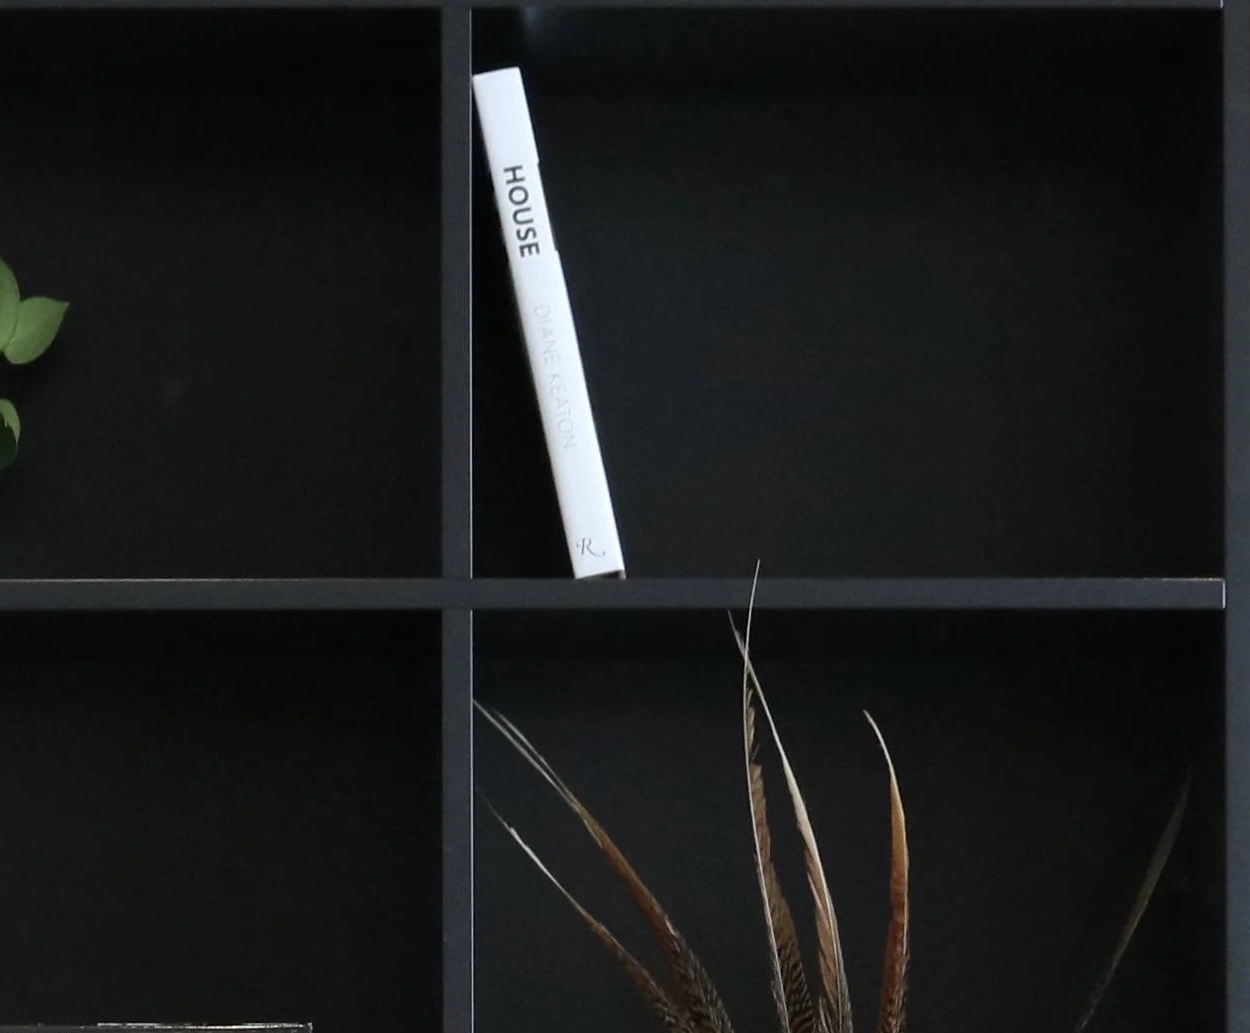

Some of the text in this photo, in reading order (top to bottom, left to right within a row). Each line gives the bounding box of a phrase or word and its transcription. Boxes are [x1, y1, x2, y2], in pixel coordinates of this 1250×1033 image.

[503, 164, 540, 258] HOUSE
[534, 304, 577, 450] DIANE KEATON
